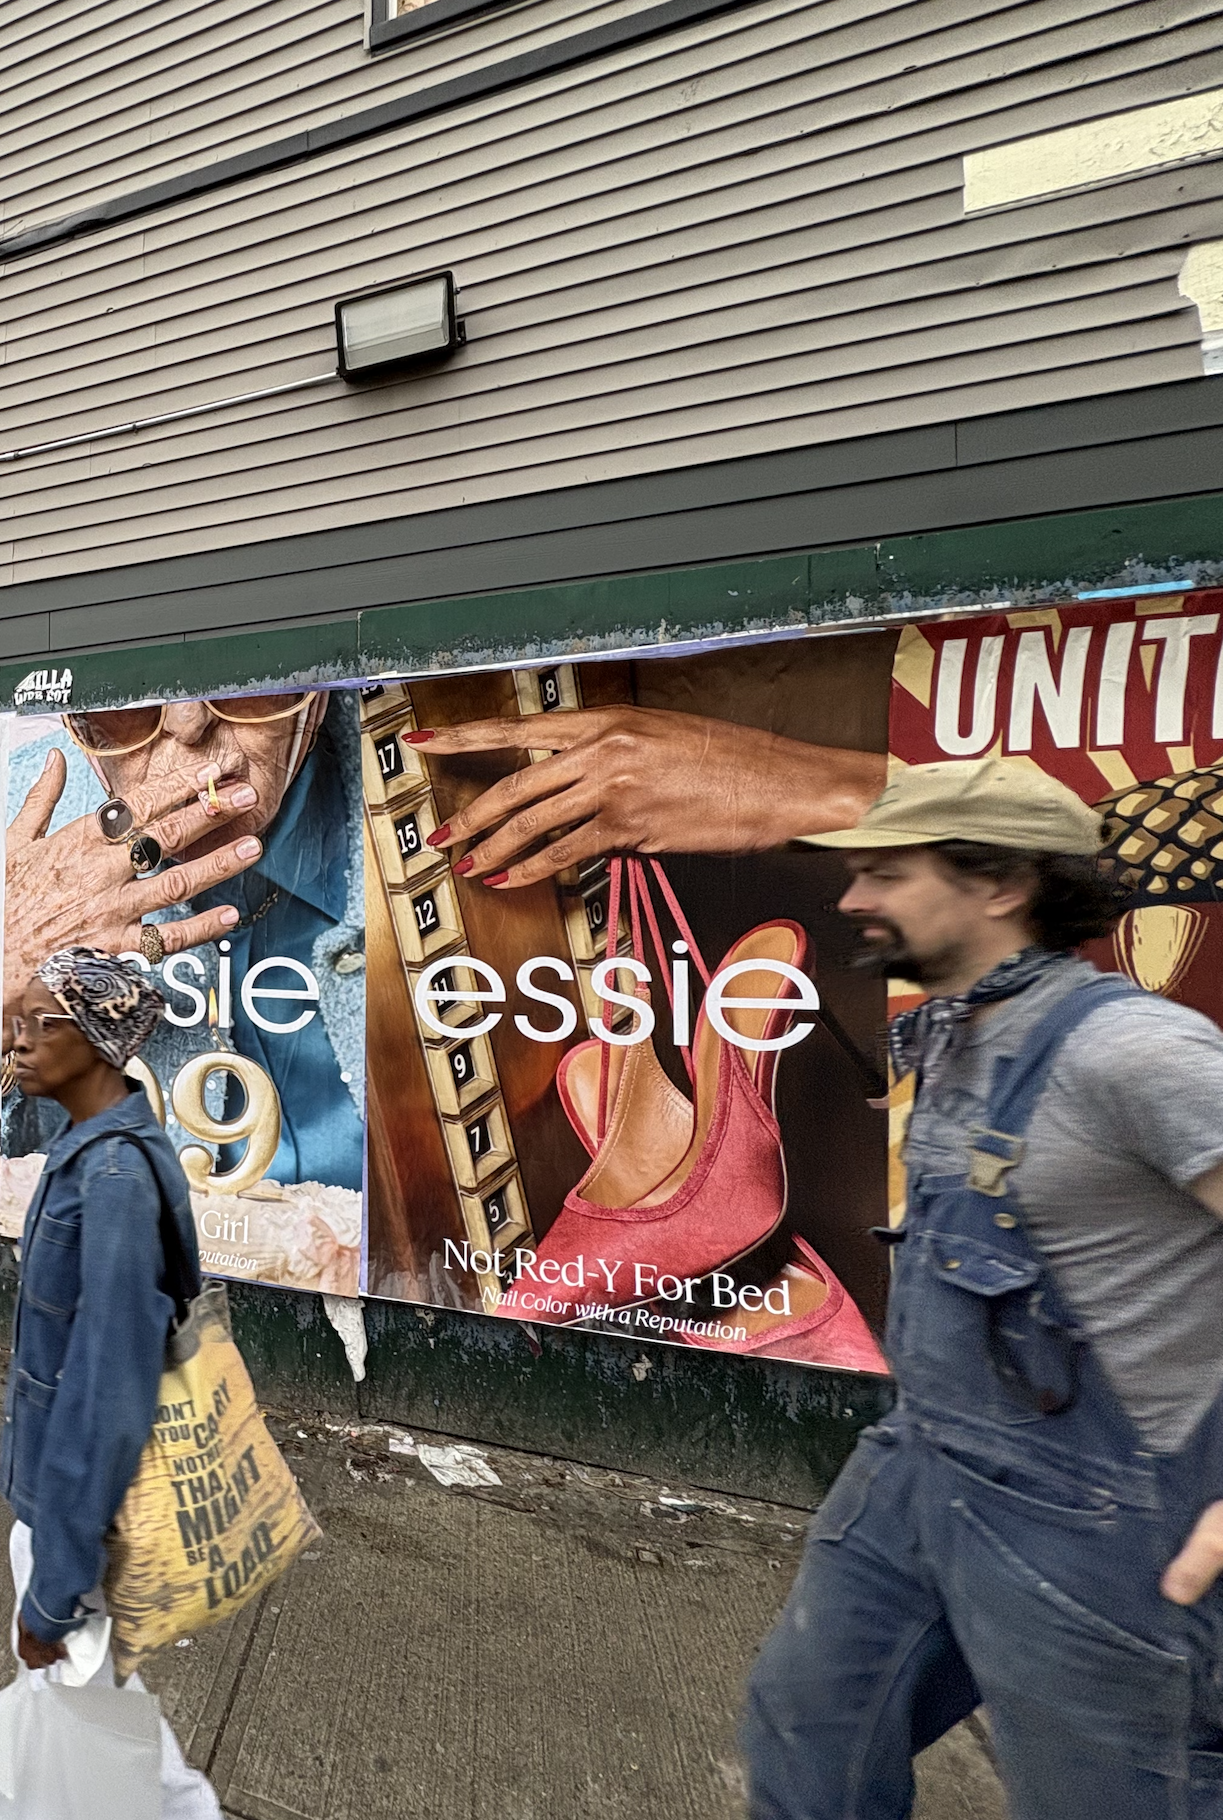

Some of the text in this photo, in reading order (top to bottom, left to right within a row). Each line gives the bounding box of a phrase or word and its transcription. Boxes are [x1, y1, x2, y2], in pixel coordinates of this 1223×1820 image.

[935, 613, 1223, 756] UNIT
[377, 742, 397, 775] 17
[396, 822, 418, 854] 15
[414, 899, 437, 930] 12
[586, 901, 603, 930] 10
[118, 939, 320, 1034] sie
[414, 940, 820, 1052] essie
[454, 1053, 466, 1079] 9
[470, 1126, 481, 1153] 7
[488, 1199, 500, 1223] 5
[200, 1210, 249, 1245] Girl
[443, 1238, 792, 1317] Not Red-Y For Bed
[481, 1286, 748, 1342] Nail Color with a Reputation
[157, 1424, 191, 1444] YOU
[187, 1543, 226, 1573] BE A
[205, 1520, 274, 1609] LOAD
